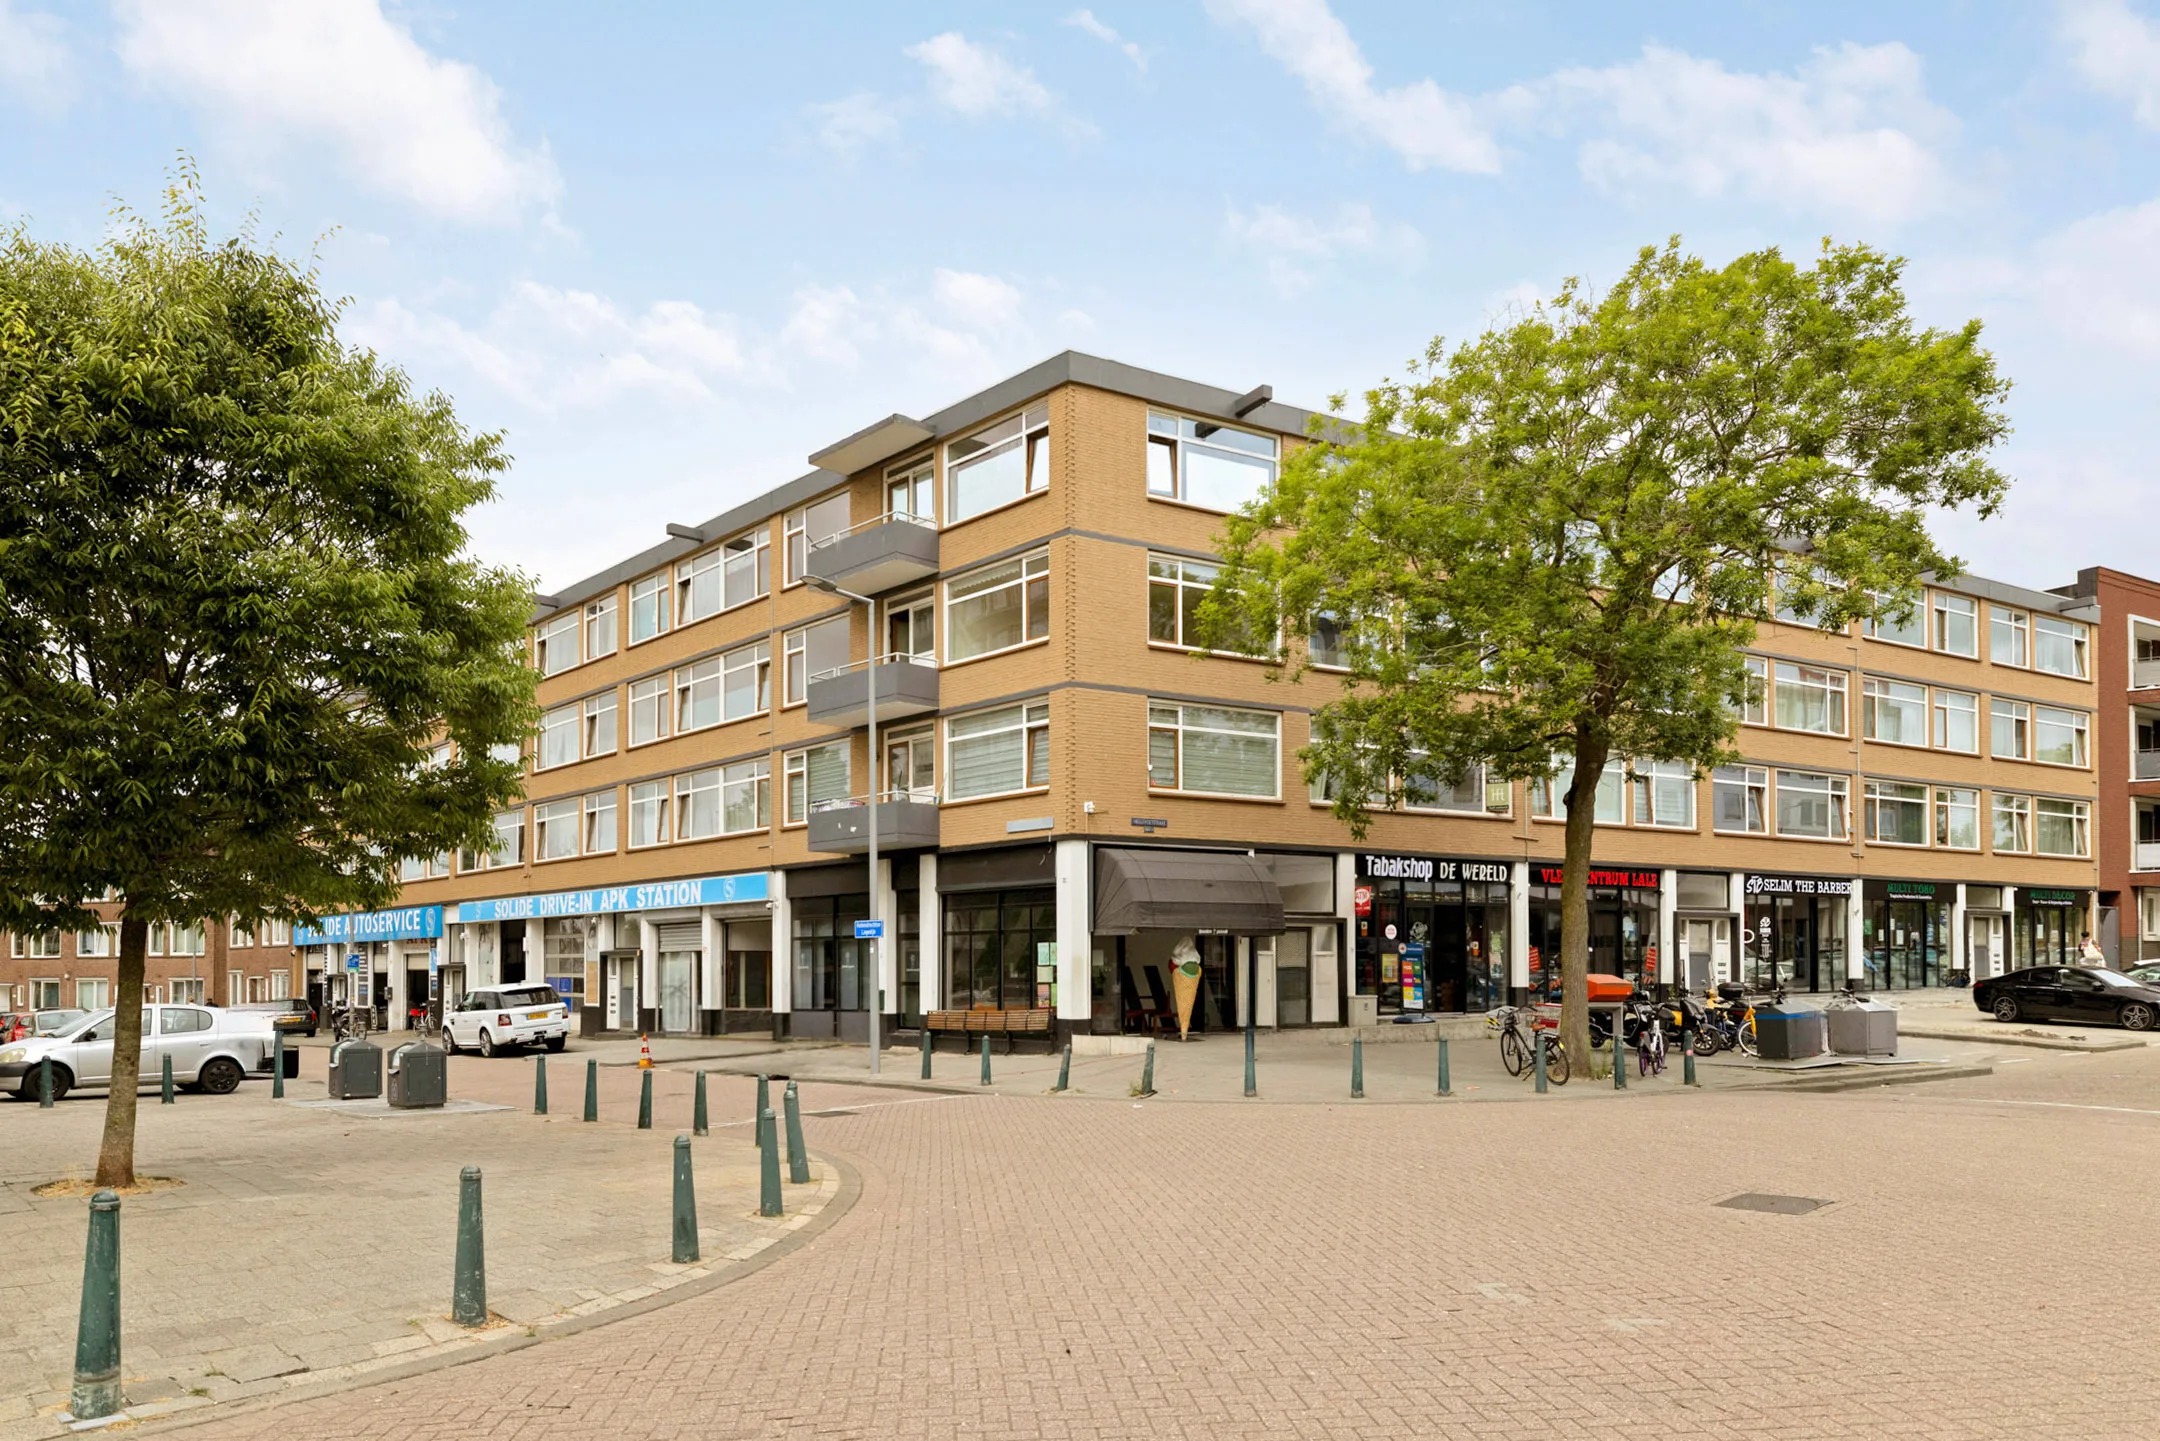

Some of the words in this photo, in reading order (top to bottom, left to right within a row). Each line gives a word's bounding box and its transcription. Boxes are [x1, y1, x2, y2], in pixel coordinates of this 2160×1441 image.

[1366, 855, 1433, 882] Tabakshop
[1440, 862, 1456, 879] DE
[1462, 863, 1508, 881] WERELD
[1541, 868, 1629, 886] VLENTRUM
[1632, 872, 1657, 887] LALE
[1764, 879, 1793, 892] SELIM
[1795, 880, 1815, 893] THE
[1817, 881, 1852, 894] BARBER
[494, 899, 533, 918] SOLIDE
[540, 891, 592, 915] DRIVE-IN
[600, 887, 629, 910] APK
[636, 881, 702, 907] STATION
